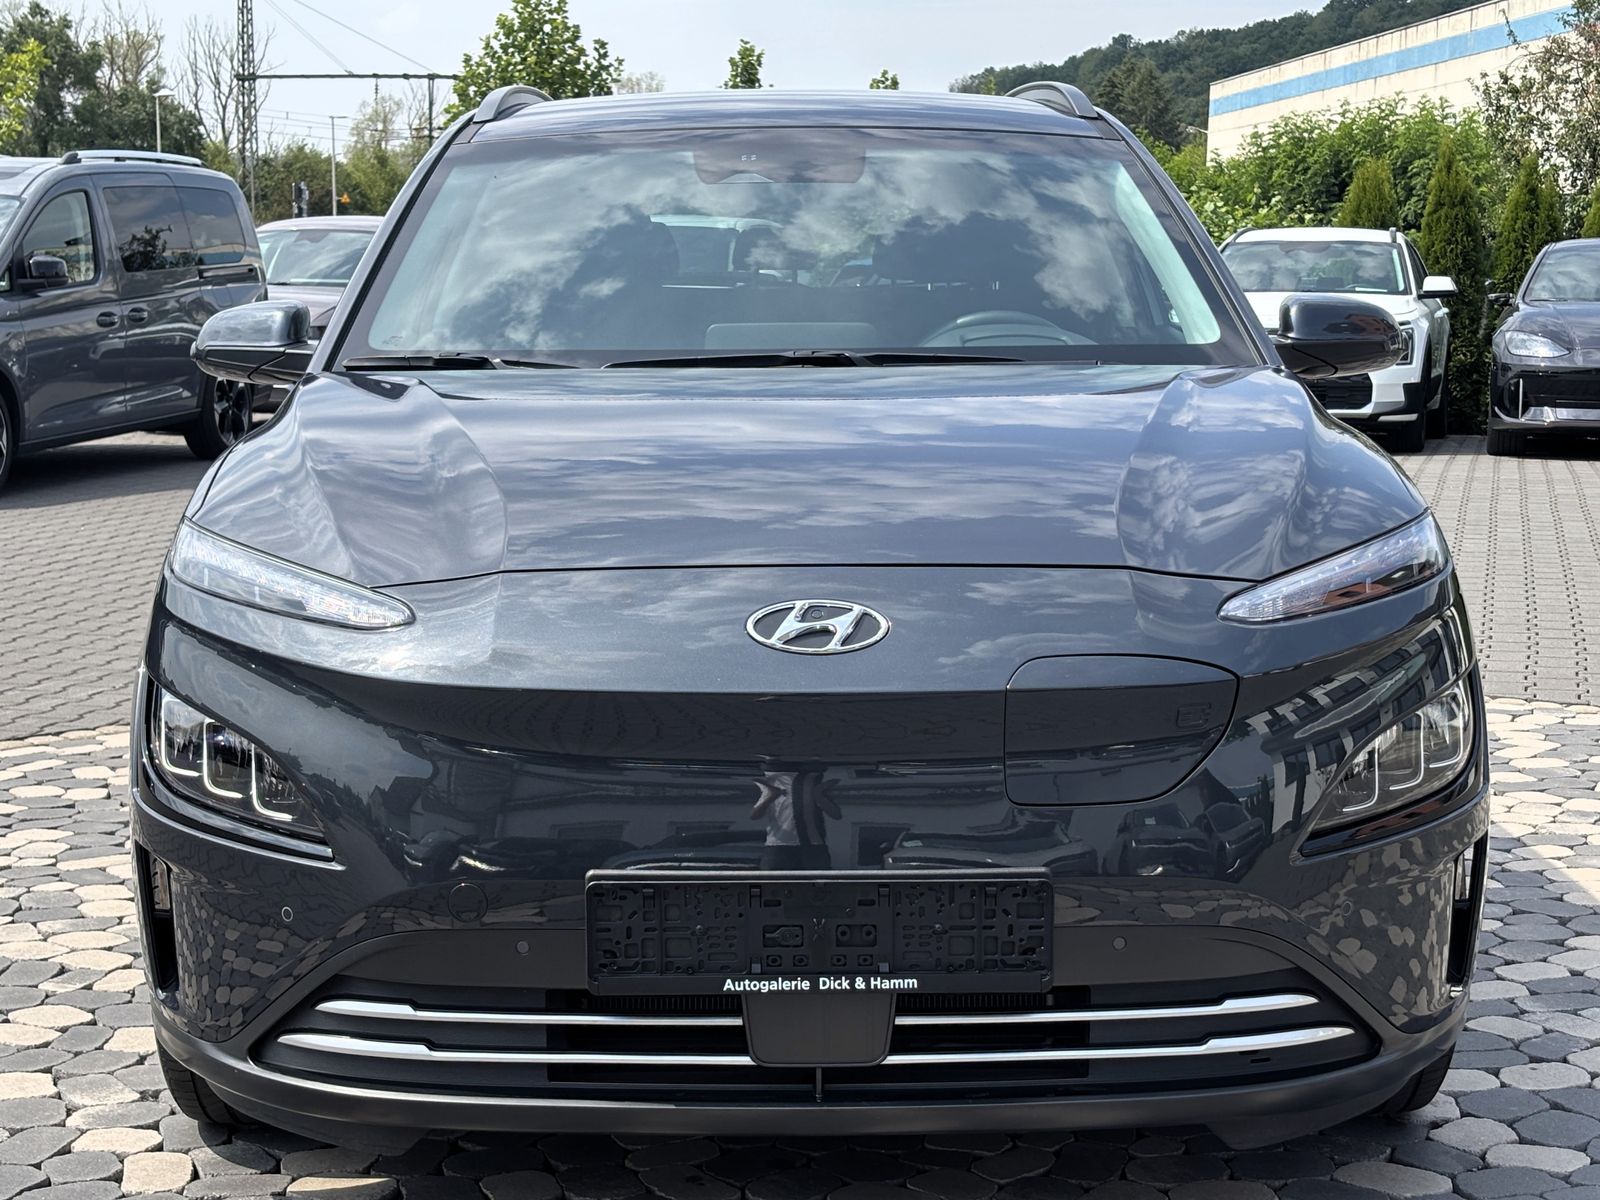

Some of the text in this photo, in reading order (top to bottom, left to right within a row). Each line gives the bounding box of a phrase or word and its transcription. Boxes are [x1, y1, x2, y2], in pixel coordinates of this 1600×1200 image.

[722, 976, 918, 993] Autogalerie Dick & Hamm
